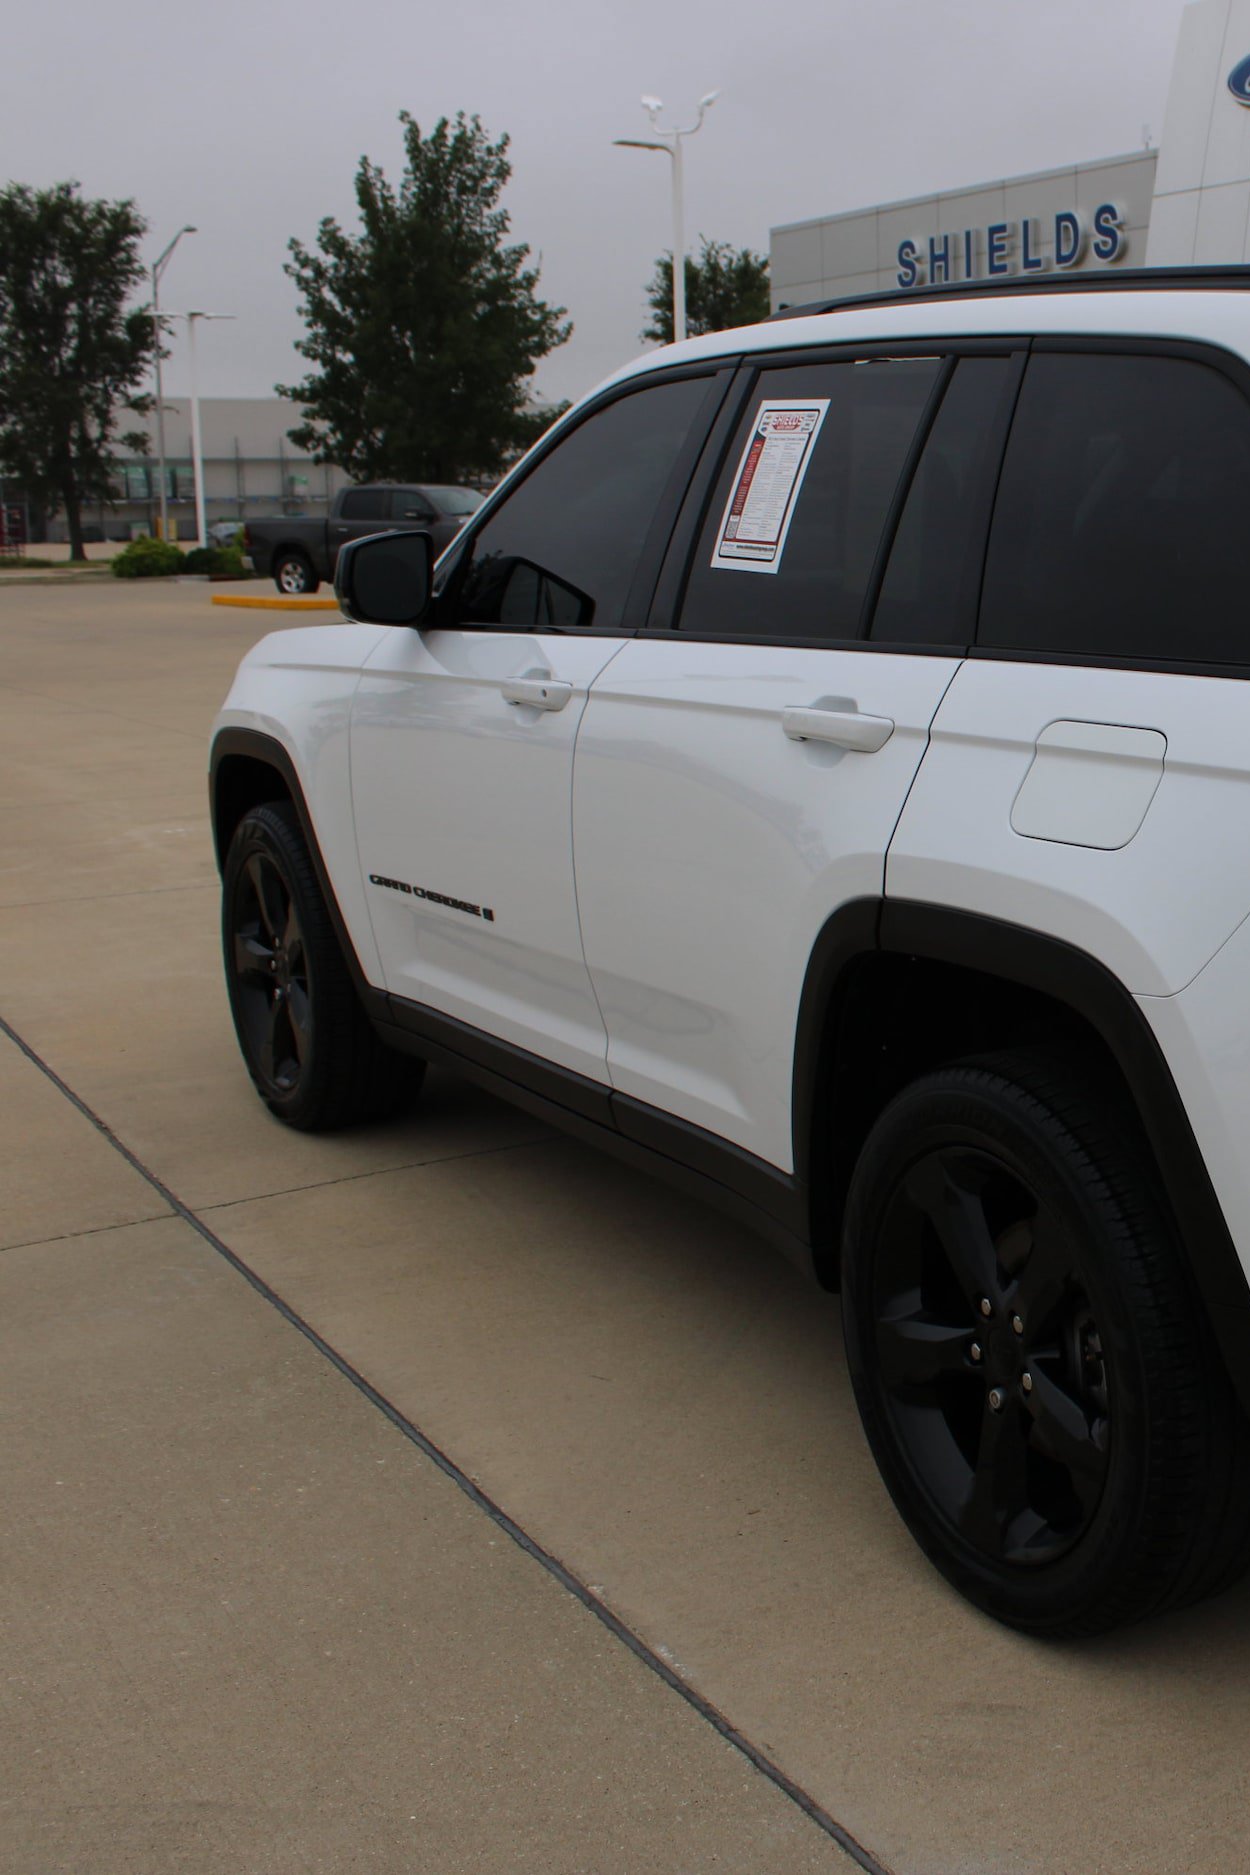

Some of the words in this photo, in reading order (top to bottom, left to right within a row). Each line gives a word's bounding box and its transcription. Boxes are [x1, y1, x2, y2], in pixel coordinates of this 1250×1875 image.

[896, 203, 1124, 289] SHIELDS
[368, 873, 412, 894] GRAND
[412, 885, 482, 917] CHEROKEE
